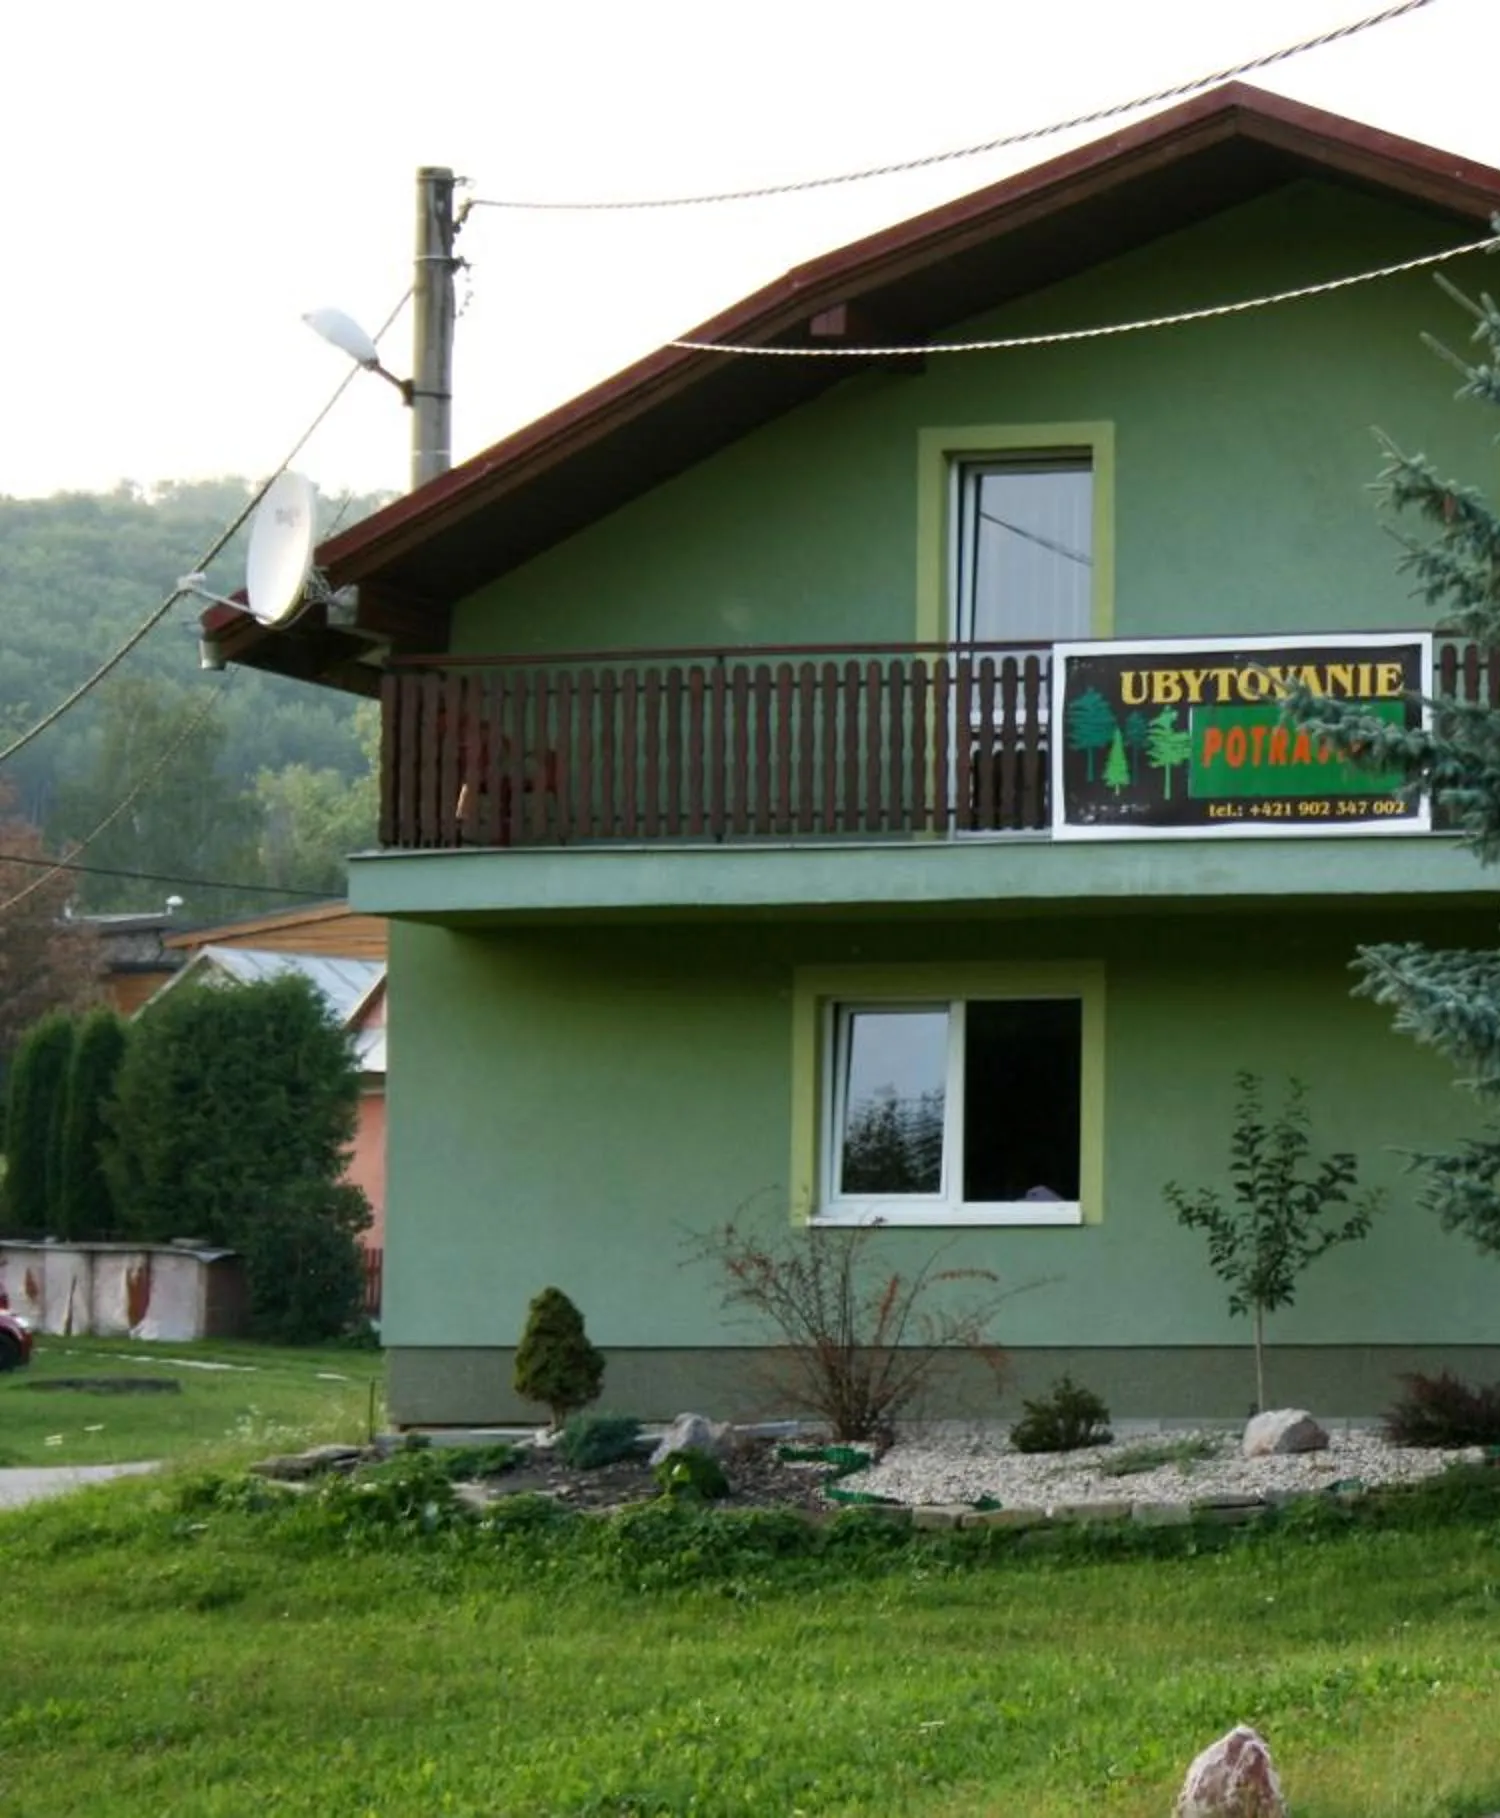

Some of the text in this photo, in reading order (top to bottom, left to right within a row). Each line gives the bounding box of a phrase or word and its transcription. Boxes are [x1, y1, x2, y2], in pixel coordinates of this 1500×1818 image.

[1120, 663, 1404, 704] UBYTOVANIE
[1209, 802, 1243, 818] tel.:
[1249, 801, 1292, 817] +421
[1298, 801, 1330, 816] 902
[1373, 799, 1406, 814] 002
